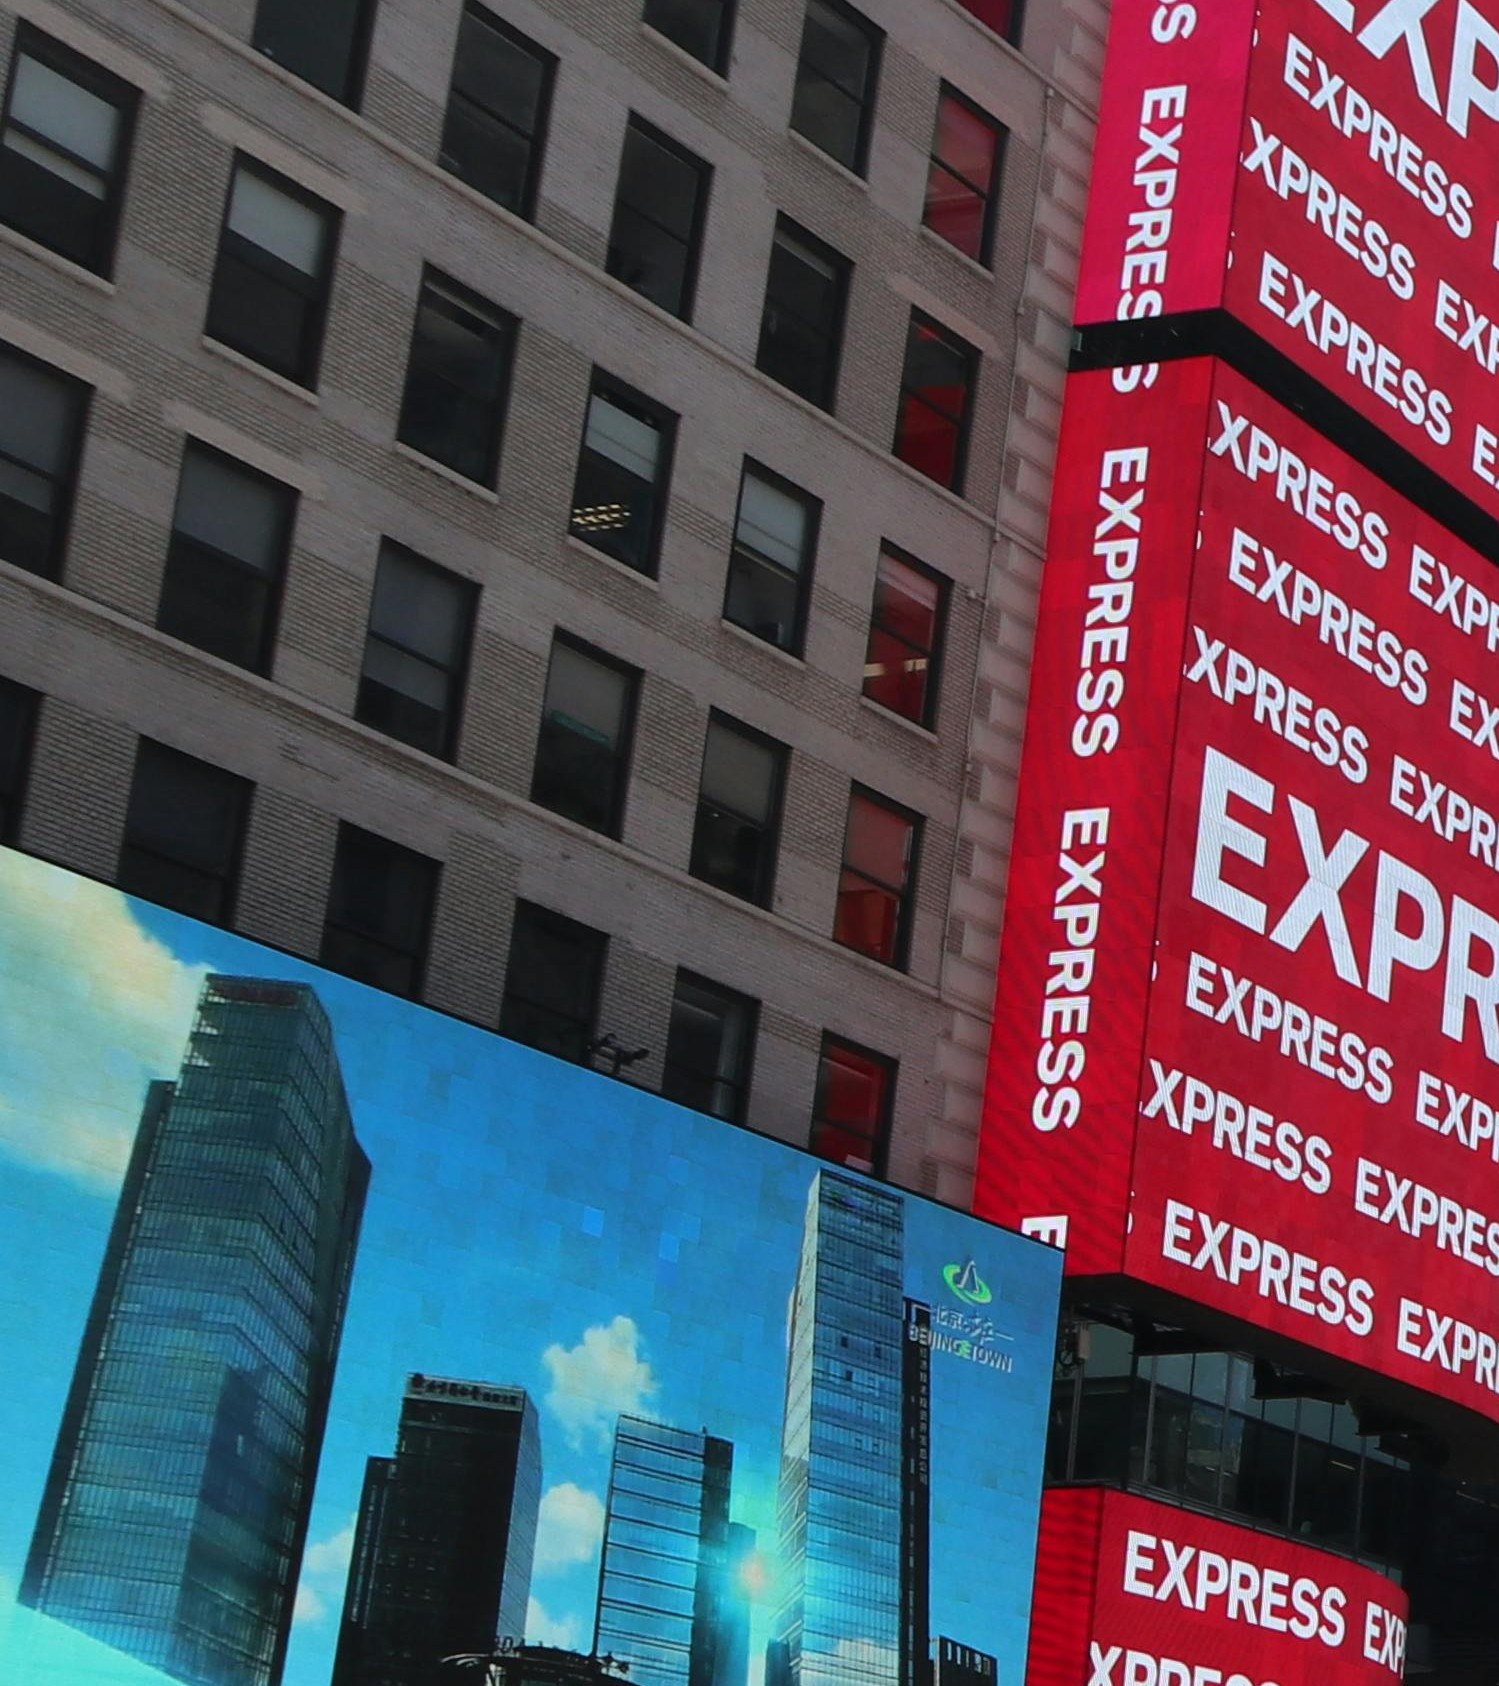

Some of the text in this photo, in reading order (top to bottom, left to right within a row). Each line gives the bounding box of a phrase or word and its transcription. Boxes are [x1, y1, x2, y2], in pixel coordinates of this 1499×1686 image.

[1241, 117, 1415, 299] XPRESS
[1283, 33, 1472, 238] EXPRESS
[1112, 84, 1188, 394] EXPRESS
[1258, 251, 1453, 446] EXPRESS
[1208, 400, 1388, 570] XPRESS
[1071, 445, 1149, 757] EXPRESS
[1228, 527, 1428, 707] EXPRESS
[1184, 626, 1369, 784] XPRESS
[1032, 806, 1110, 1132] EXPRESS
[1186, 952, 1393, 1105] EXPRESS
[1140, 1058, 1333, 1195] XPRESS
[1161, 1199, 1373, 1336] EXPRESS
[1123, 1529, 1346, 1647] EXPRESS
